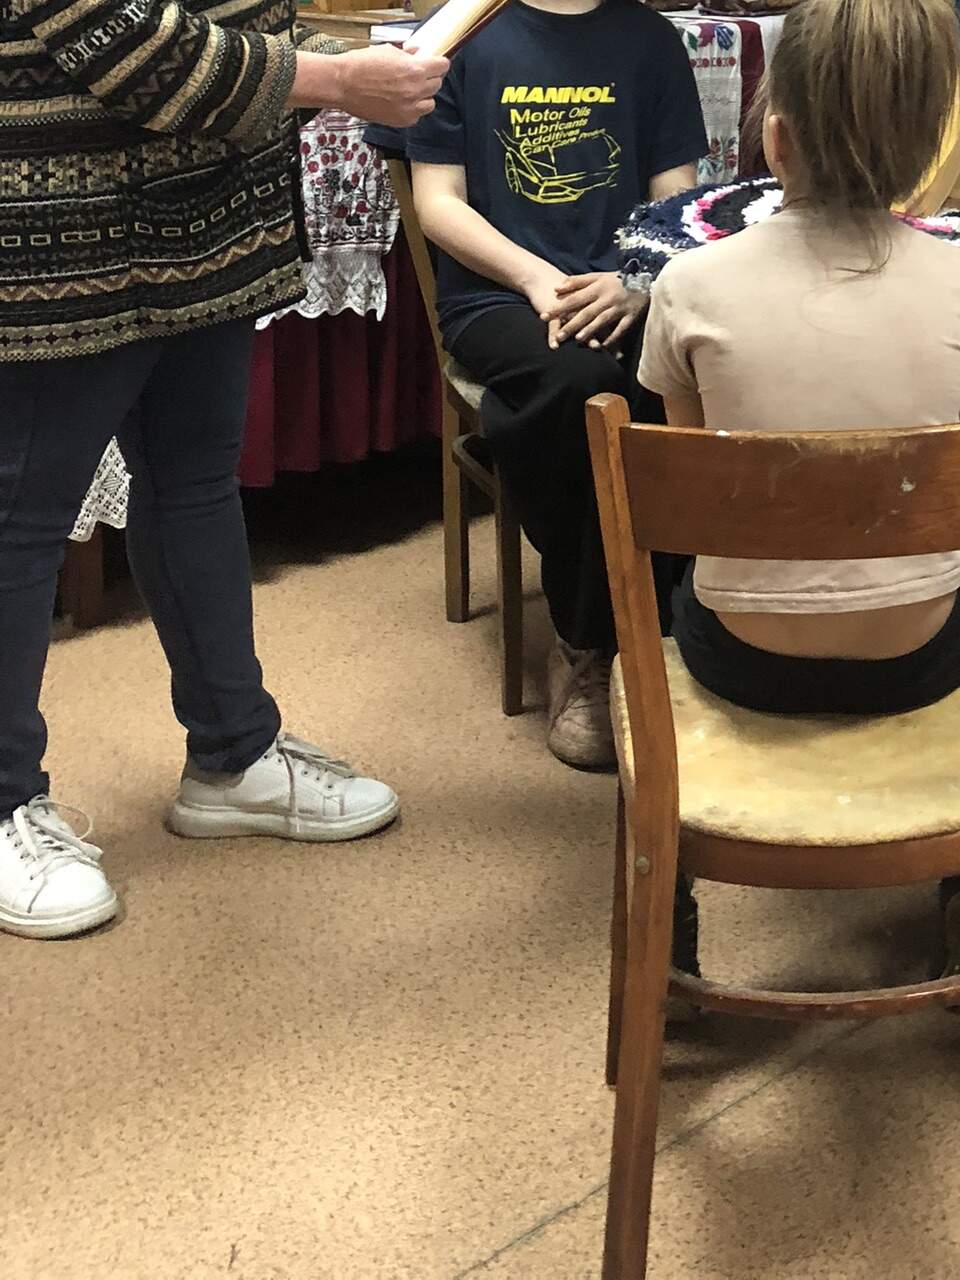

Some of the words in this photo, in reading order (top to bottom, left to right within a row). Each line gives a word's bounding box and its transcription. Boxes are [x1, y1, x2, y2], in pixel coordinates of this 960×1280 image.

[501, 86, 616, 104] MANNOL
[510, 108, 566, 124] Motor
[568, 106, 592, 119] Oils
[514, 118, 589, 139] Lubricants
[520, 128, 580, 147] Additives
